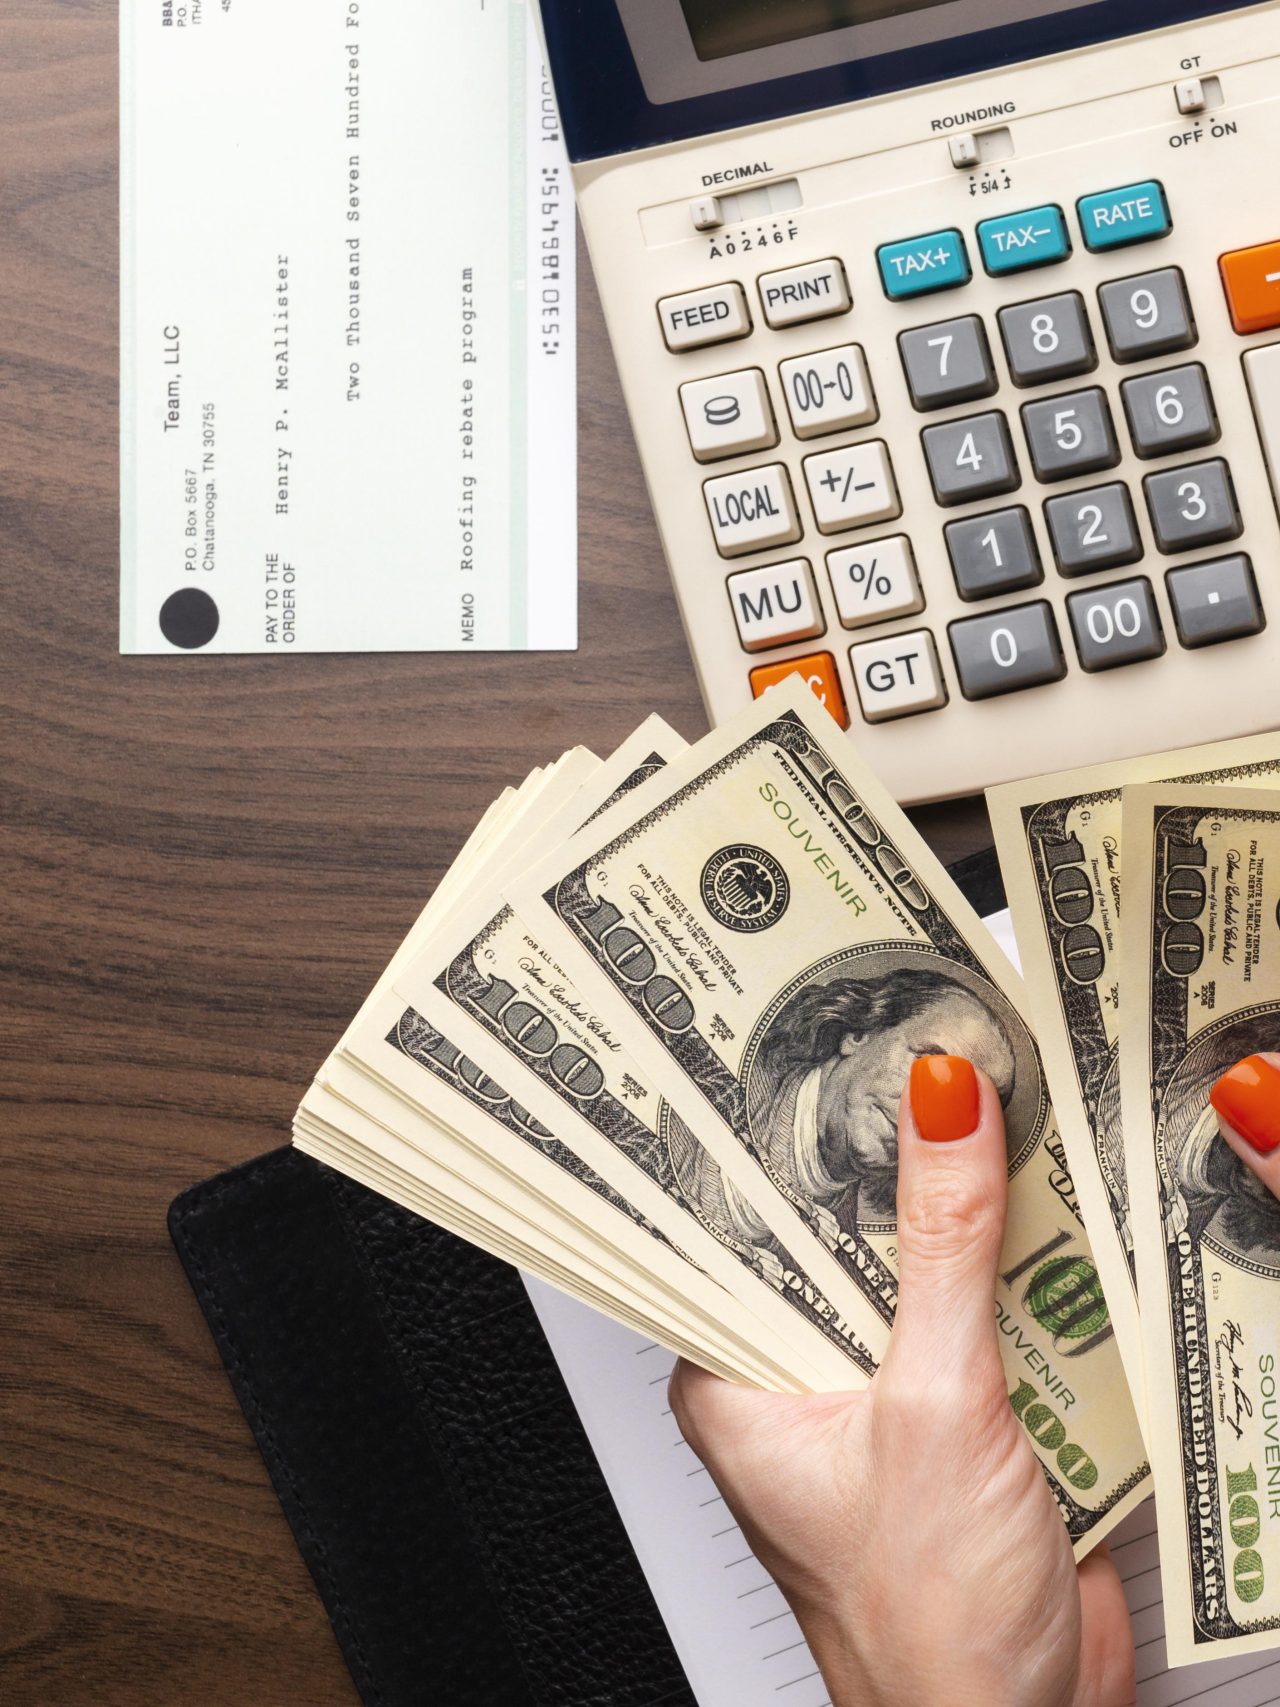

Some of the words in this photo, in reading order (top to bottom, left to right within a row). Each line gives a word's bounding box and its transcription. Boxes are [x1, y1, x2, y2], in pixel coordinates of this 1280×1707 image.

[1180, 55, 1202, 71] GT
[345, 45, 360, 137] Hundred
[930, 101, 1016, 131] ROUNDING
[1168, 129, 1204, 149] OFF
[1210, 121, 1238, 138] ON
[346, 155, 360, 221] Seven
[701, 161, 774, 186] DECIMAL
[981, 179, 999, 194] 5/4
[1092, 197, 1153, 228] RATE
[709, 246, 722, 259] A
[726, 243, 736, 255] 0
[741, 239, 753, 251] 2
[757, 235, 768, 247] 4
[773, 232, 783, 244] 6
[788, 227, 799, 241] F
[890, 247, 952, 278] TAX+
[345, 239, 360, 345] Thousand
[765, 275, 833, 308] PRINT
[1129, 289, 1158, 329] 9
[274, 255, 289, 390] McAllister
[462, 268, 477, 363] program
[670, 300, 731, 331] FEED
[1031, 313, 1060, 354] 8
[164, 326, 180, 365] LLC
[926, 335, 955, 378] 7
[347, 363, 359, 401] Two
[164, 374, 182, 433] Team,
[275, 409, 289, 432] P.
[459, 379, 473, 460] rebate
[1155, 385, 1185, 425] 6
[202, 403, 215, 447] 30755
[1054, 409, 1083, 451] 5
[203, 452, 215, 472] TN
[956, 432, 984, 473] 4
[185, 469, 198, 504] 5667
[275, 447, 293, 514] Henry
[712, 484, 780, 528] LOCAL
[1177, 482, 1208, 522] 3
[185, 511, 197, 537] Box
[459, 476, 477, 571] Roofing
[1077, 504, 1108, 546] 2
[185, 547, 197, 571] P.O.
[266, 553, 279, 584] THE
[981, 529, 1005, 568] 1
[282, 562, 296, 584] OF
[266, 588, 279, 610] TO
[282, 588, 296, 644] ORDER
[461, 594, 475, 642] MEMO
[738, 580, 803, 625] MU
[266, 614, 278, 644] PAY
[1086, 597, 1142, 645] 00
[990, 628, 1018, 669] 0
[865, 653, 920, 694] GT
[758, 782, 868, 918] SOUVENIR
[772, 750, 828, 827] FEDERAL
[826, 819, 886, 895] RESERVE
[884, 893, 918, 938] NOTE
[1250, 840, 1258, 855] FOR
[1249, 856, 1257, 873] ALL
[1257, 857, 1265, 874] THIS
[1256, 874, 1264, 899] NOTE
[656, 874, 673, 895] THIS
[670, 893, 689, 916] NOTE
[686, 912, 695, 924] IS
[691, 920, 714, 948] LEGAL
[711, 945, 738, 976] TENDER
[1039, 830, 1106, 986] 100
[1160, 836, 1208, 979] 100
[1246, 901, 1255, 931] PUBLIC
[1254, 906, 1263, 935] LEGAL
[637, 863, 652, 881] FOR
[650, 878, 664, 896] ALL
[682, 920, 708, 951] PUBLIC
[705, 948, 721, 968] AND
[718, 963, 745, 997] PRIVATE
[1245, 931, 1253, 950] AND
[1253, 935, 1261, 965] TENDER
[522, 935, 539, 952] FOR
[539, 949, 554, 966] ALL
[573, 893, 696, 1033] 100
[662, 951, 681, 974] United
[1244, 950, 1253, 983] PRIVATE
[467, 973, 606, 1099] 100
[561, 1020, 584, 1042] United
[1096, 1134, 1117, 1190] FRANKLIN
[1157, 1121, 1170, 1181] FRANKLIN
[763, 1158, 800, 1204] FRANKLIN
[696, 1209, 739, 1249] FRANKLIN
[837, 1232, 884, 1288] ONE
[1177, 1230, 1196, 1300] ONE
[782, 1269, 836, 1321] ONE
[1007, 1376, 1099, 1490] 100
[1226, 1460, 1266, 1604] 100
